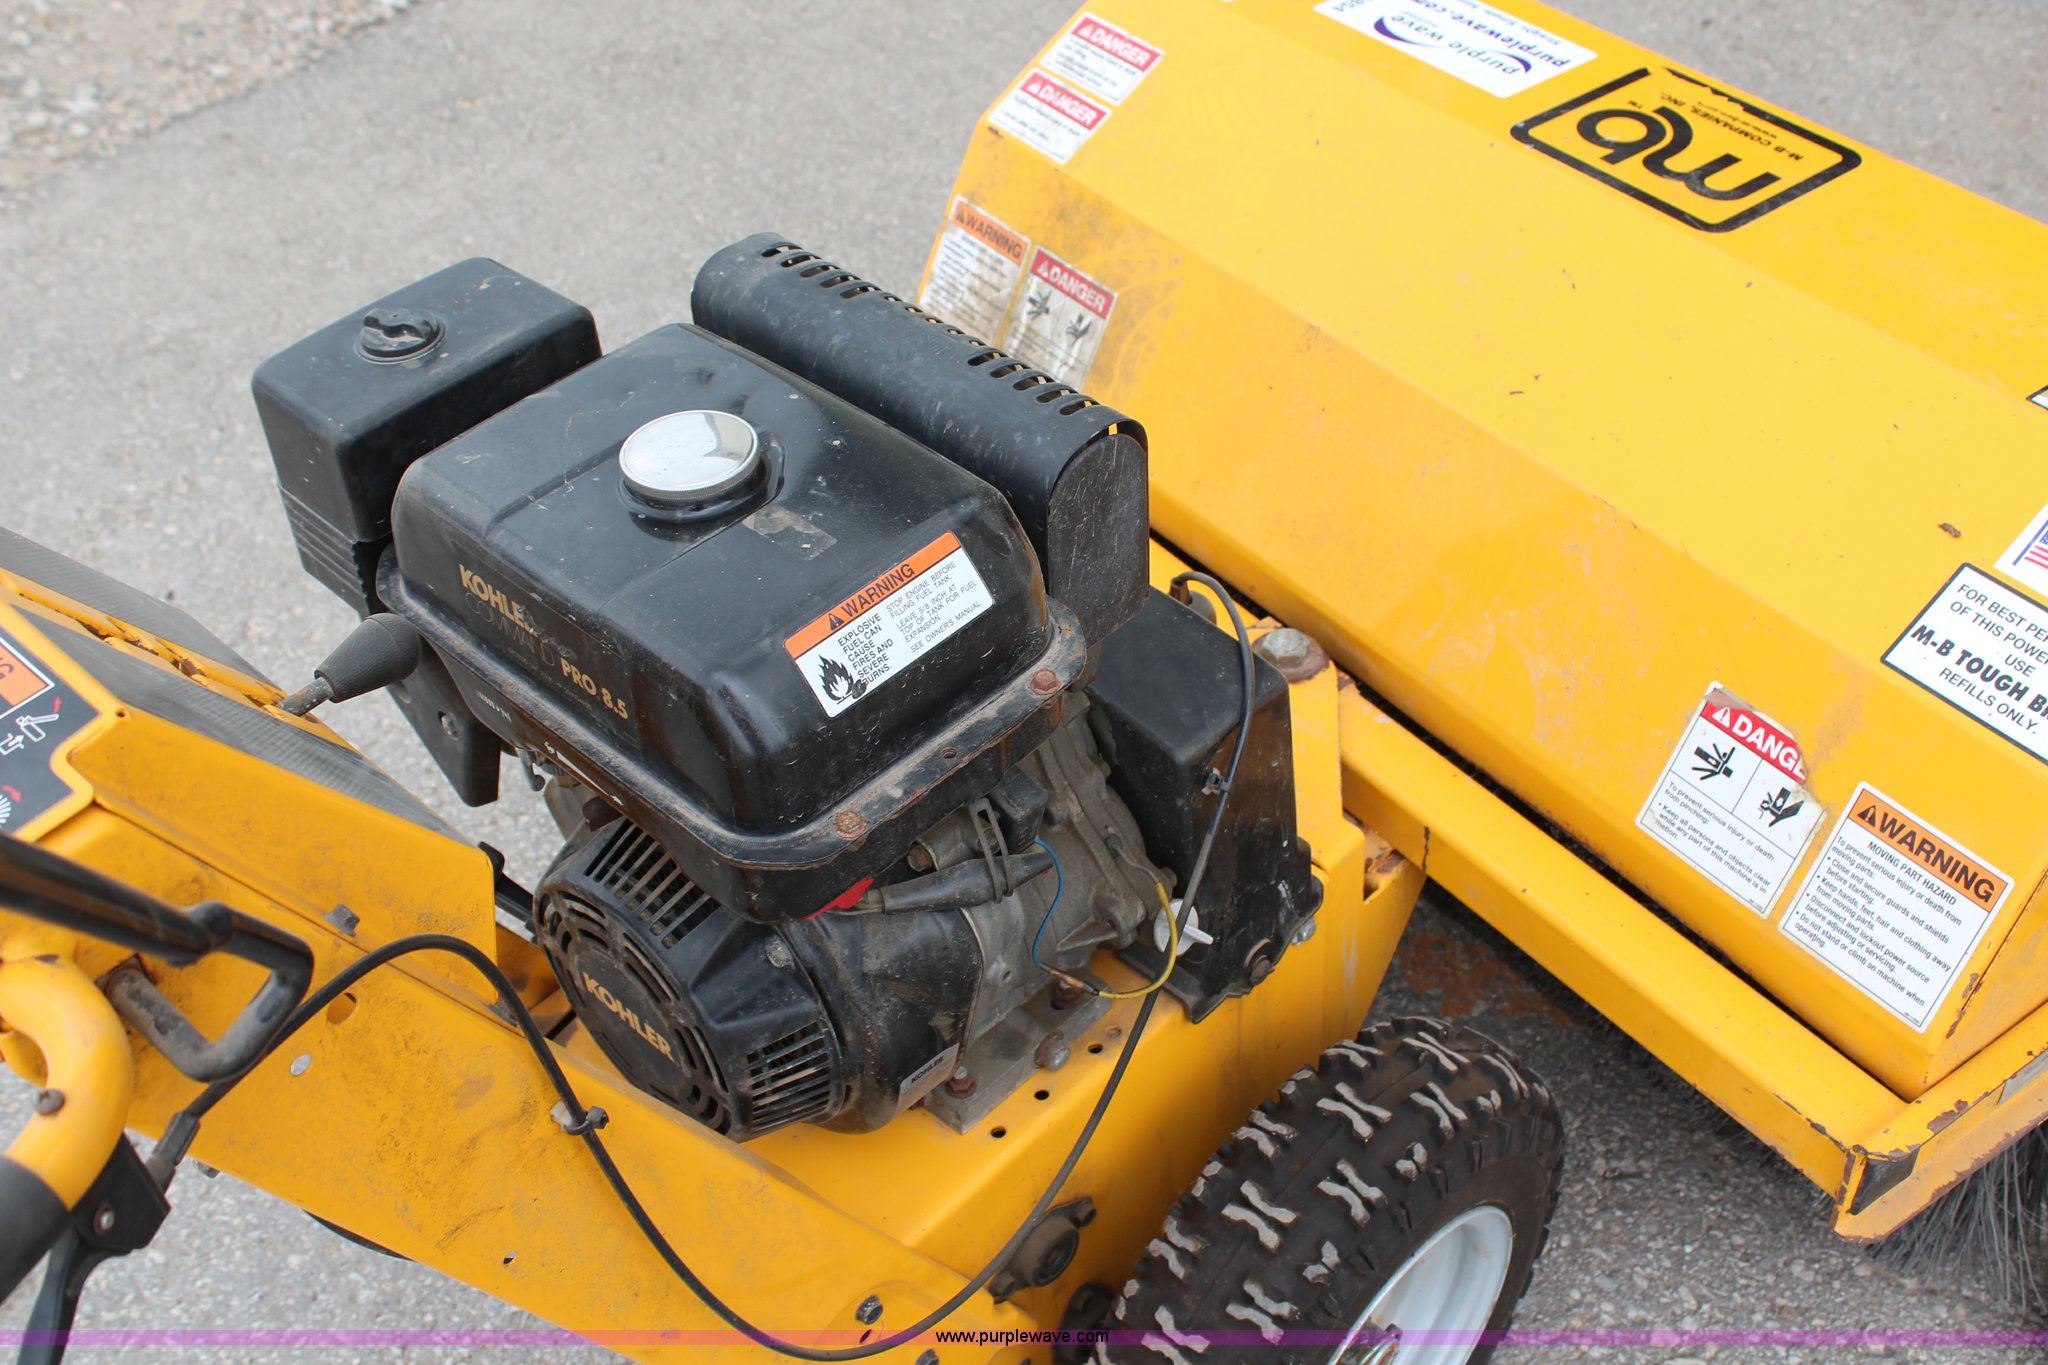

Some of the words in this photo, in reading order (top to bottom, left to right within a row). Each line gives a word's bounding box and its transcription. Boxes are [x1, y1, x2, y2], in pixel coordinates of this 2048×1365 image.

[1091, 27, 1151, 67] DANGER
[1391, 15, 1443, 41] wave
[1449, 41, 1520, 74] purple
[1039, 85, 1097, 126] DANGER
[965, 214, 1022, 259] WARNING
[1049, 267, 1105, 313] DANGER
[459, 564, 540, 637] KOHLE
[840, 563, 915, 617] WARNING
[885, 596, 903, 612] STOP
[904, 579, 929, 599] ENGINE
[930, 560, 956, 582] BEFORE
[889, 599, 914, 618] FILLING
[915, 588, 933, 601] FUEL
[896, 610, 917, 629] LEAVE
[918, 602, 929, 614] 5/8
[930, 590, 947, 605] INCH
[948, 583, 956, 593] AT
[899, 622, 913, 635] TOP
[915, 614, 924, 625] OF
[926, 602, 944, 616] TANK
[944, 591, 959, 603] FOR
[959, 580, 977, 593] FUEL
[1957, 584, 1988, 608] FOR
[1988, 601, 2027, 627] BEST
[837, 613, 881, 646] EXPLOSIVE
[842, 637, 864, 654] FUEL
[863, 624, 881, 639] CAN
[910, 639, 924, 652] SEE
[925, 618, 954, 642] OWNER'S
[1950, 601, 1972, 616] OF
[1972, 611, 2004, 637] THIS
[847, 639, 875, 662] CAUSE
[852, 650, 876, 670] FIRES
[876, 638, 893, 654] AND
[857, 652, 889, 680] SEVERE
[1911, 625, 1955, 657] M-B
[1955, 649, 2029, 701] TOUGH
[2004, 654, 2036, 677] USE
[561, 658, 596, 696] PRO
[602, 688, 628, 719] 8.5
[861, 663, 891, 687] BURNS.
[1939, 668, 1997, 706] REFILLS
[1997, 703, 2038, 734] ONLY.
[1731, 713, 1806, 780] DANGE
[1664, 788, 1679, 802] from
[1679, 801, 1709, 824] pinching:
[1669, 781, 1677, 791] To
[1676, 789, 1702, 809] prevent
[1702, 807, 1726, 826] serious
[1726, 823, 1746, 841] injury
[1745, 838, 1754, 846] or
[1754, 844, 1774, 861] death
[1659, 812, 1675, 827] while
[1675, 825, 1688, 837] any
[1687, 834, 1702, 846] part
[1710, 849, 1723, 862] this
[1723, 860, 1751, 882] machine
[1752, 880, 1758, 888] is
[1759, 885, 1766, 894] in
[1662, 804, 1679, 820] Keep
[1679, 818, 1688, 826] all
[1687, 824, 1714, 846] persons
[1714, 844, 1728, 855] and
[1728, 853, 1752, 873] objects
[1753, 872, 1770, 886] clear
[1831, 845, 1856, 866] moving
[1879, 811, 1994, 903] WARNING
[1826, 866, 1847, 885] before
[1847, 882, 1873, 904] starting.
[1836, 835, 1845, 846] To
[1844, 843, 1871, 863] prevent
[1870, 860, 1895, 880] serious
[1895, 877, 1915, 895] injury
[1915, 891, 1924, 899] or
[1924, 897, 1944, 913] death
[1944, 910, 1961, 925] from
[1867, 841, 1899, 867] MOVING
[1899, 863, 1922, 881] PART
[1921, 878, 1956, 905] HAZARD
[1815, 884, 1831, 900] from
[1831, 897, 1856, 918] moving
[1820, 876, 1837, 892] Keep
[1837, 888, 1858, 909] hands,
[1860, 904, 1874, 919] feet,
[1875, 915, 1890, 928] hair
[1889, 926, 1904, 938] and
[1903, 935, 1932, 959] clothing
[1931, 955, 1951, 972] away
[1831, 858, 1850, 875] Close
[1849, 872, 1864, 884] and
[1863, 881, 1886, 900] secure
[1885, 897, 1910, 916] guards
[1909, 914, 1925, 926] and
[1923, 923, 1949, 944] shields
[1799, 912, 1809, 923] Do
[1809, 921, 1821, 932] not
[1820, 929, 1840, 945] stand
[1839, 942, 1848, 950] or
[1847, 948, 1866, 964] climb
[1866, 962, 1876, 971] on
[1876, 969, 1905, 992] machine
[1905, 990, 1924, 1006] when
[1805, 903, 1826, 921] before
[1825, 919, 1856, 944] adjusting
[1856, 940, 1865, 948] or
[1864, 946, 1895, 972] servicing.
[1810, 894, 1846, 924] Disconnect
[1845, 921, 1860, 933] and
[1859, 929, 1885, 951] lockout
[1883, 948, 1906, 966] power
[1905, 964, 1929, 983] source
[583, 972, 675, 1062] KOHLER
[912, 1056, 944, 1083] KOHLER
